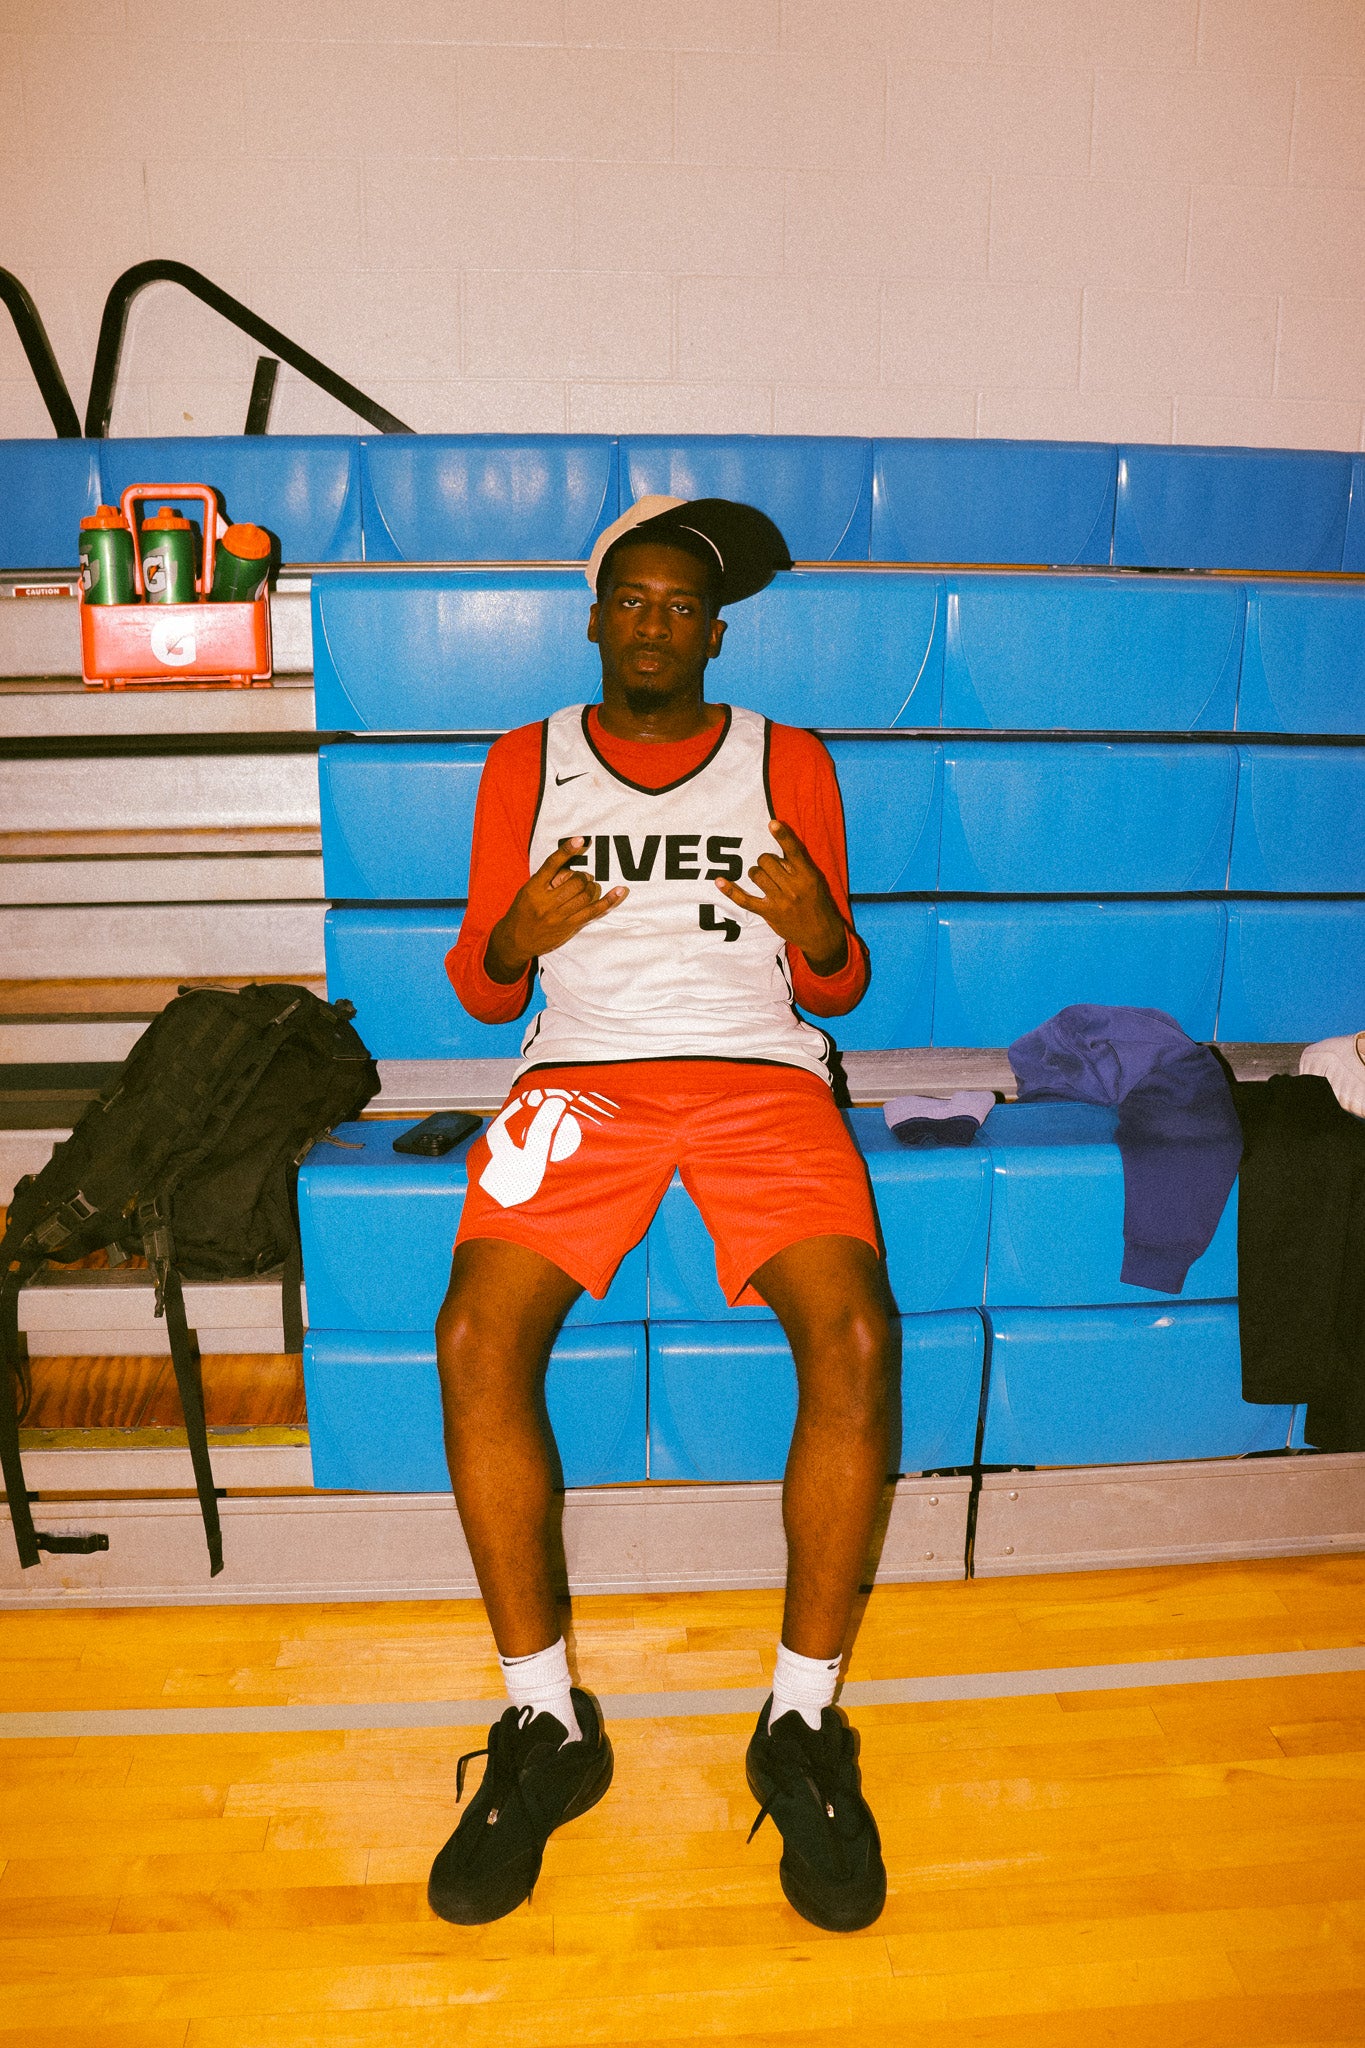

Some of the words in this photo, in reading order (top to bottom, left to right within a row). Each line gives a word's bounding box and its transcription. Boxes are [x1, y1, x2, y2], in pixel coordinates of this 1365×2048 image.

[25, 588, 60, 596] CAUTION
[142, 555, 168, 594] G
[150, 615, 197, 667] G
